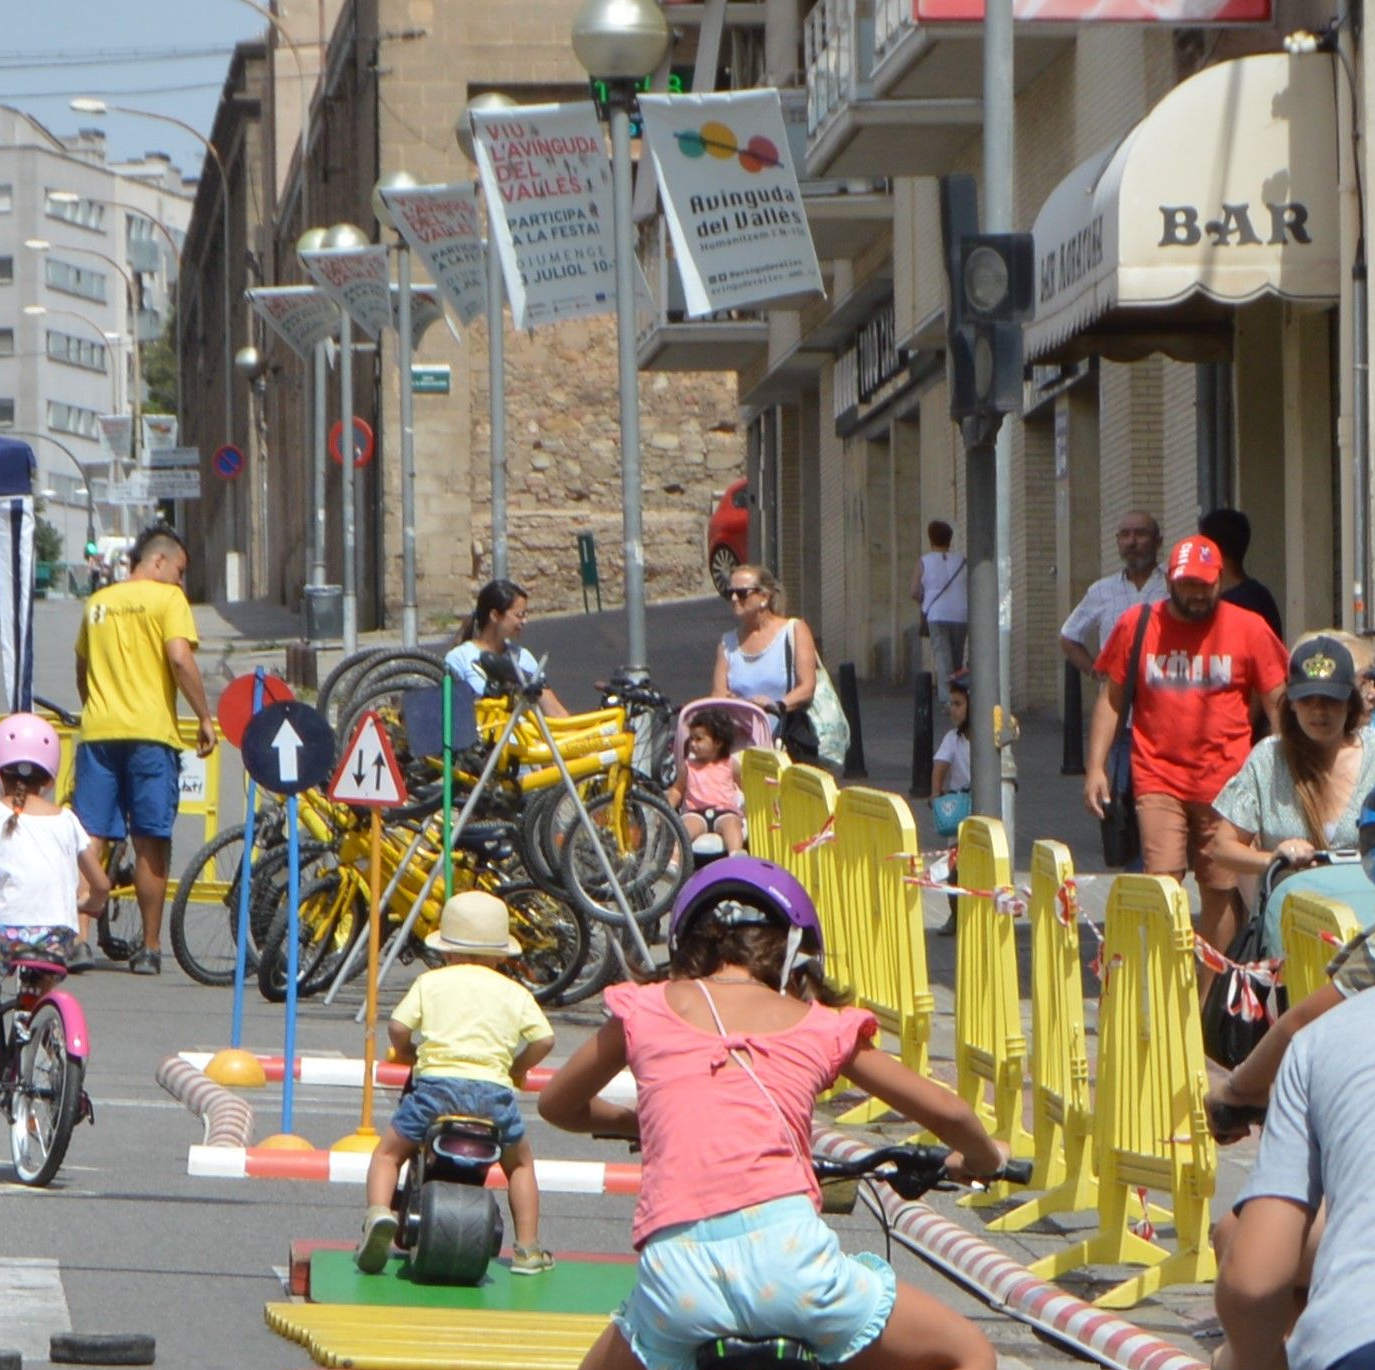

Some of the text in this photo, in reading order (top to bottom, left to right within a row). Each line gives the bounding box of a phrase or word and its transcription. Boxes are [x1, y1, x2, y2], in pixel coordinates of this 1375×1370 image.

[485, 122, 525, 140] VIU
[490, 136, 599, 161] L'AVINGUDA
[495, 161, 542, 183] DEL
[690, 185, 796, 215] Avinguda
[507, 208, 586, 231] PARTICIPA
[697, 217, 730, 239] del
[1158, 202, 1313, 247] BAR
[527, 229, 548, 244] LA
[533, 264, 588, 283] JULIOL
[1145, 649, 1233, 686] KÖLN
